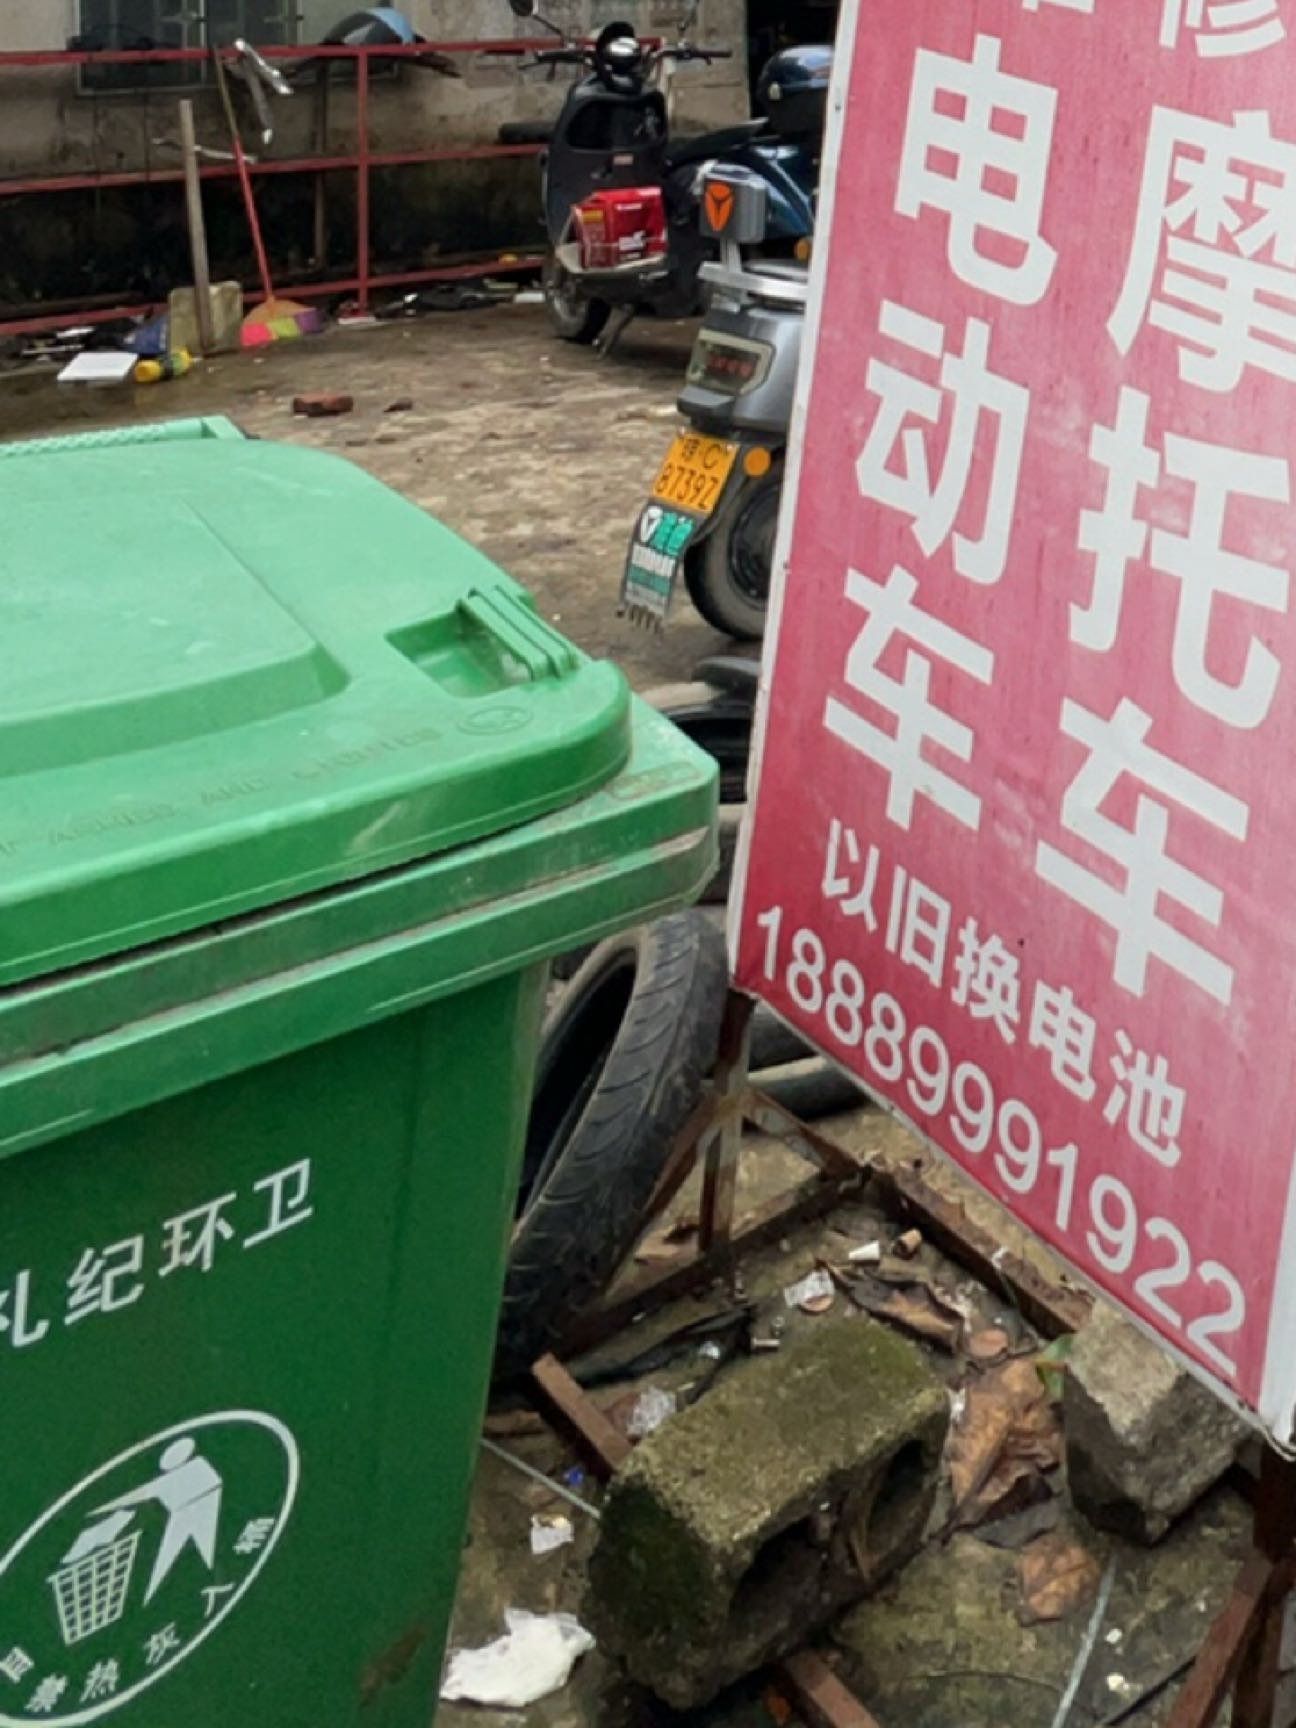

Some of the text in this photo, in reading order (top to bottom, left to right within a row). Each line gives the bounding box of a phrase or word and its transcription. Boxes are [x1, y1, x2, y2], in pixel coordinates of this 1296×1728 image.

[823, 33, 1059, 832] 电动车
[756, 905, 1246, 1375] 18889991922
[821, 818, 1188, 1168] 以旧换电池
